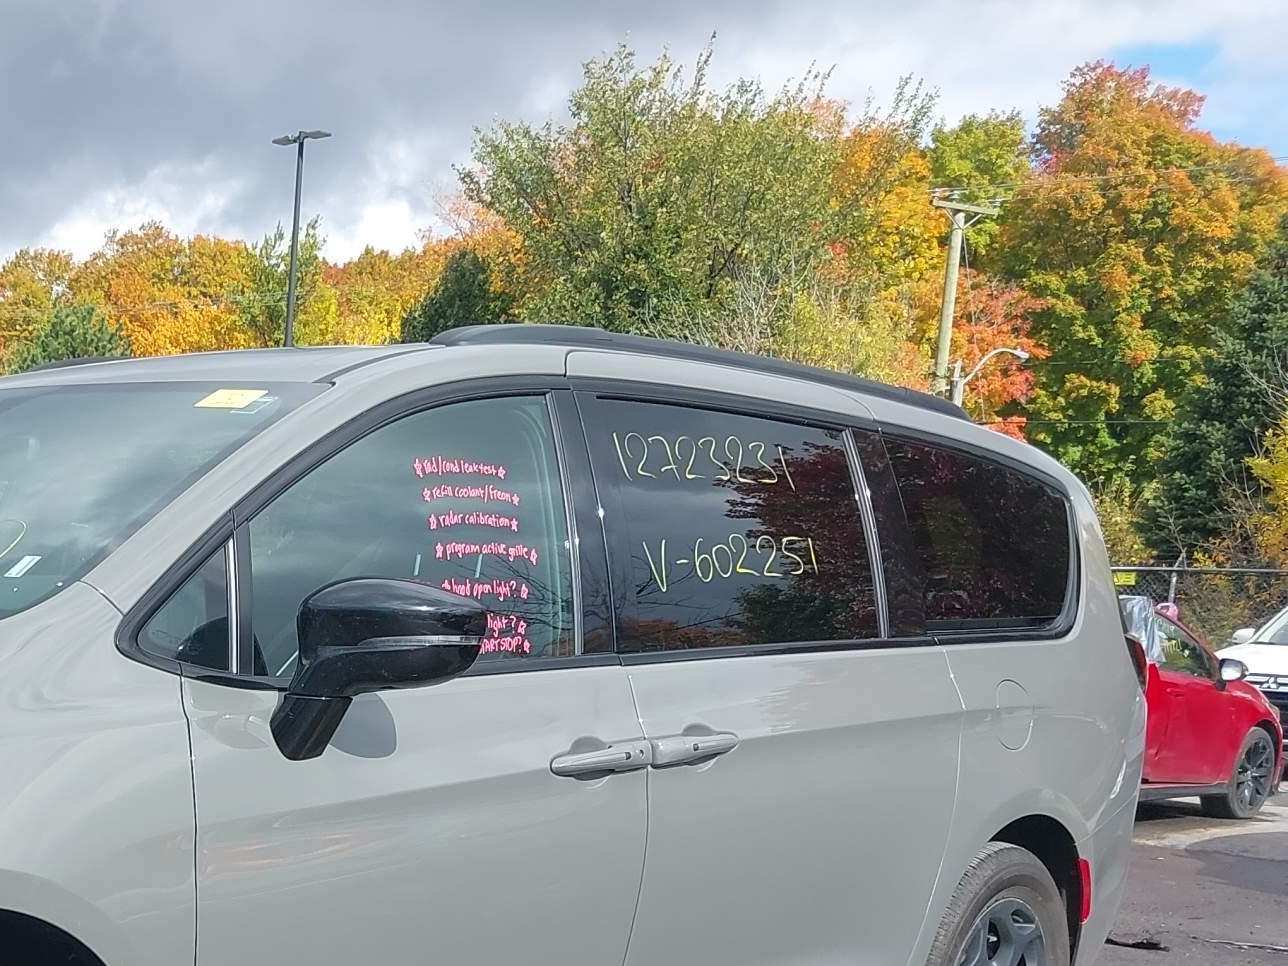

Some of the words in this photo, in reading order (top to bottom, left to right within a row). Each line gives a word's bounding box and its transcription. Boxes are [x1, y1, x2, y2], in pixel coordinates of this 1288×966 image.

[612, 432, 797, 492] 12723231
[432, 484, 453, 499] refill
[438, 510, 463, 528] radar
[464, 512, 510, 528] calibration
[446, 542, 480, 561] program
[481, 542, 507, 555] active
[508, 544, 529, 562] grille
[642, 533, 819, 593] V-602251
[473, 582, 492, 600] open
[492, 579, 517, 601] light?
